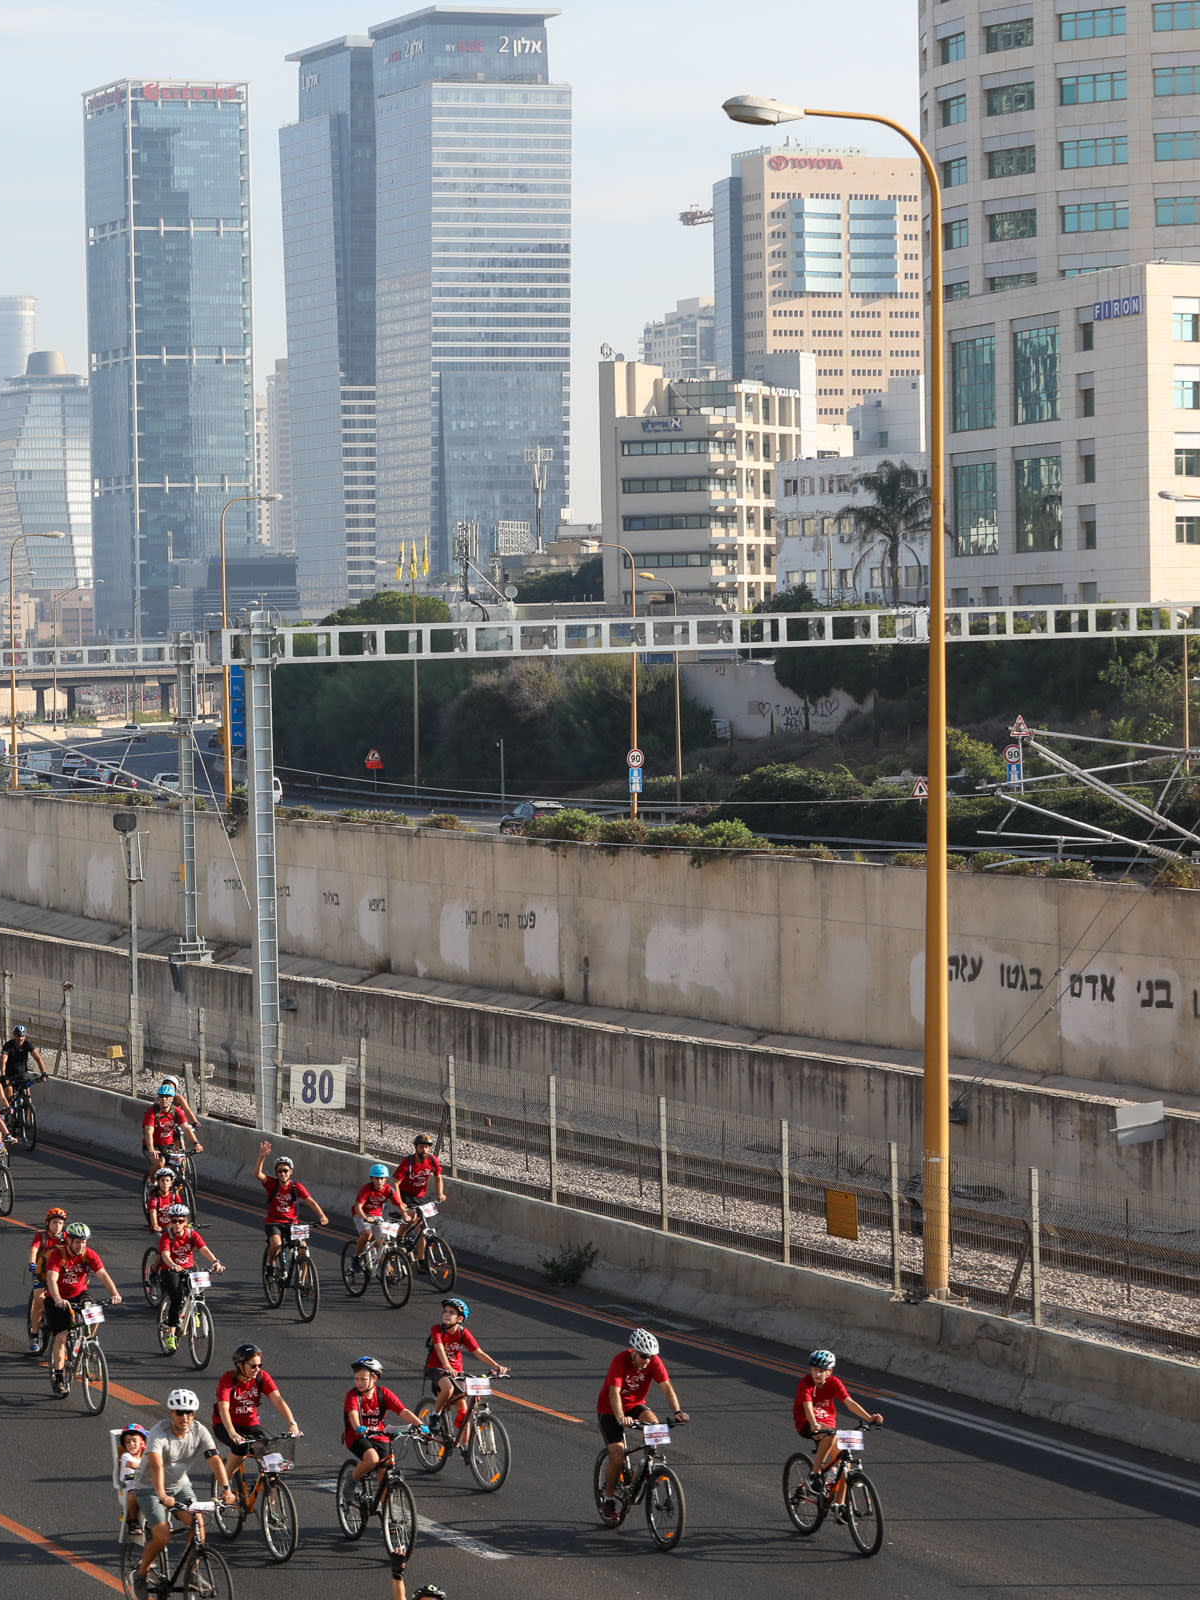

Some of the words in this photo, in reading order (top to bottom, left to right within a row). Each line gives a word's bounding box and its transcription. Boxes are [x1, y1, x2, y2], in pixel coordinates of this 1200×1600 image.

[445, 44, 455, 52] BY
[498, 36, 509, 53] 2
[513, 36, 543, 56] אלון
[160, 88, 235, 100] ELECTRA
[790, 157, 843, 170] TOYOTA
[1094, 298, 1139, 319] FIRON
[631, 755, 641, 763] 90
[1007, 750, 1019, 759] 90
[947, 954, 984, 983] עזה
[1000, 963, 1044, 991] בגטו
[1069, 973, 1115, 1002] אדם
[1136, 979, 1174, 1008] בני
[301, 1069, 334, 1104] 80
